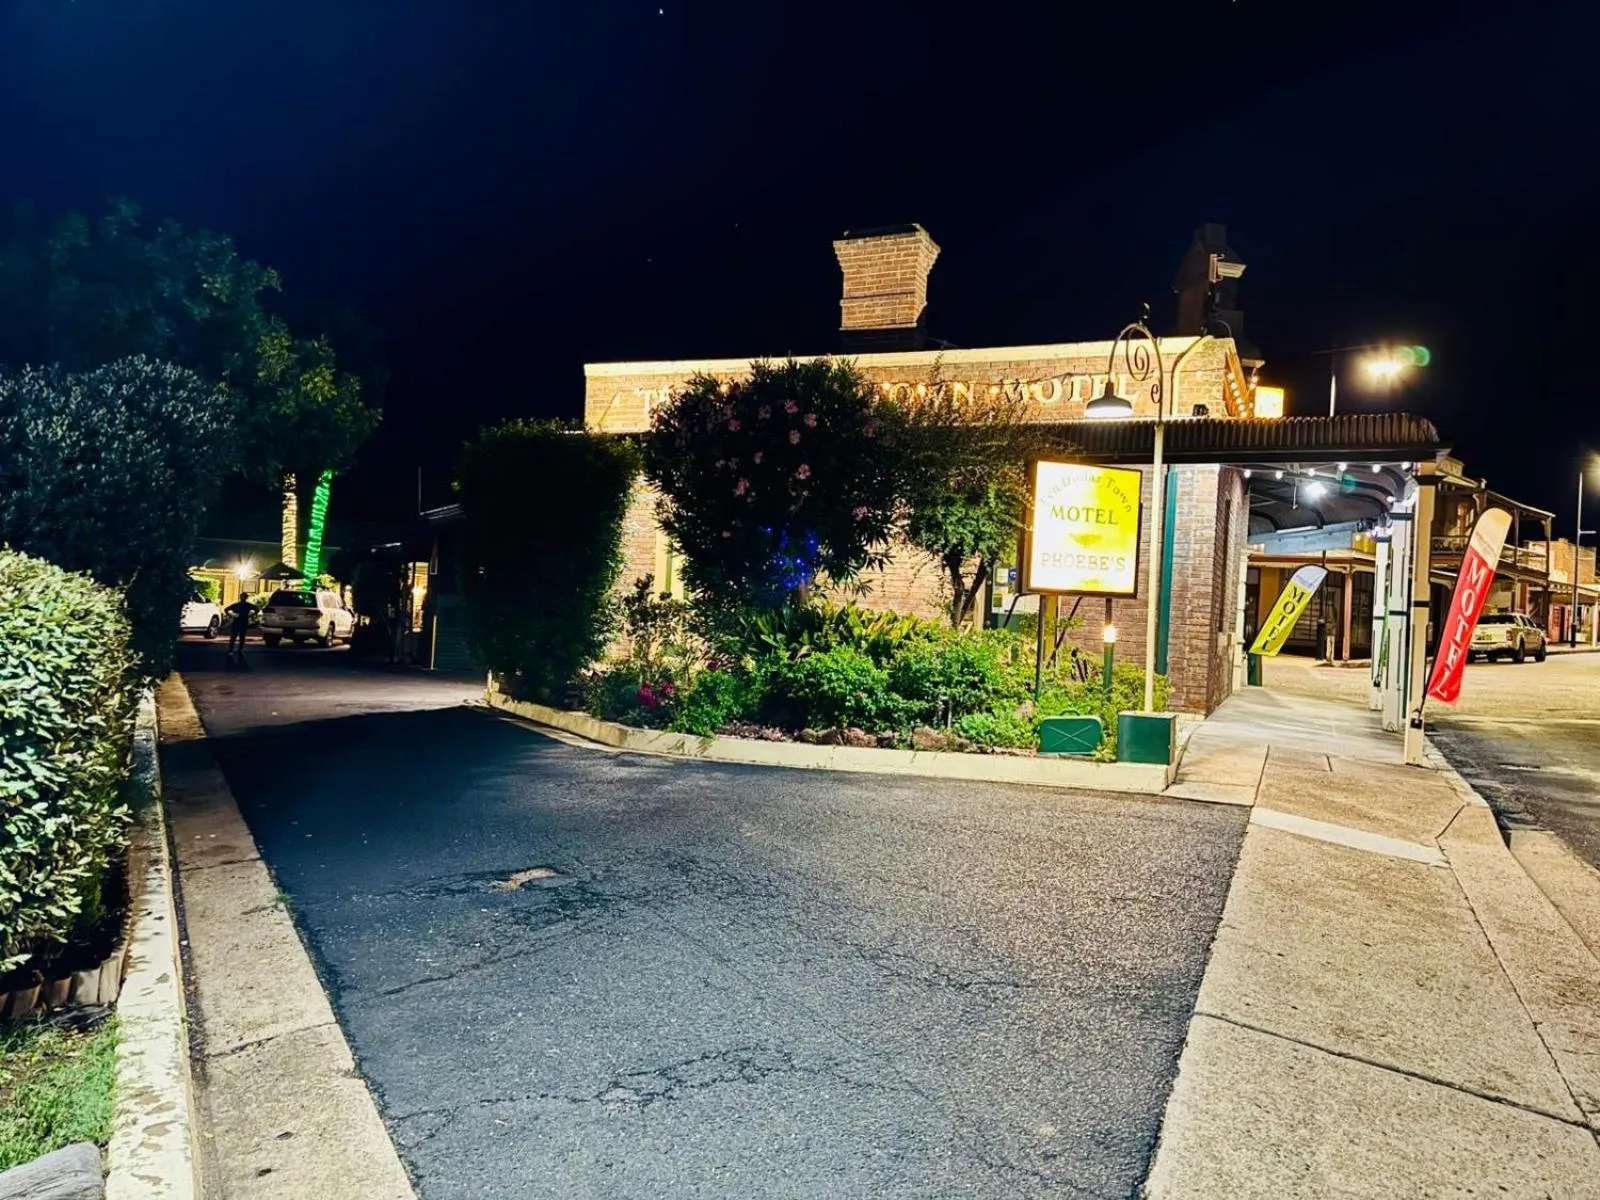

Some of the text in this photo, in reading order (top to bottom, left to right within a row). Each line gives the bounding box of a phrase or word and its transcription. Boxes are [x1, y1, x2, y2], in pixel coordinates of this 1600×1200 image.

[1105, 476, 1132, 514] Town
[1050, 505, 1118, 526] MOTEL
[1041, 552, 1126, 572] PHOEBE'S
[1261, 585, 1305, 653] MOTEL
[1436, 555, 1488, 698] MOTEL
